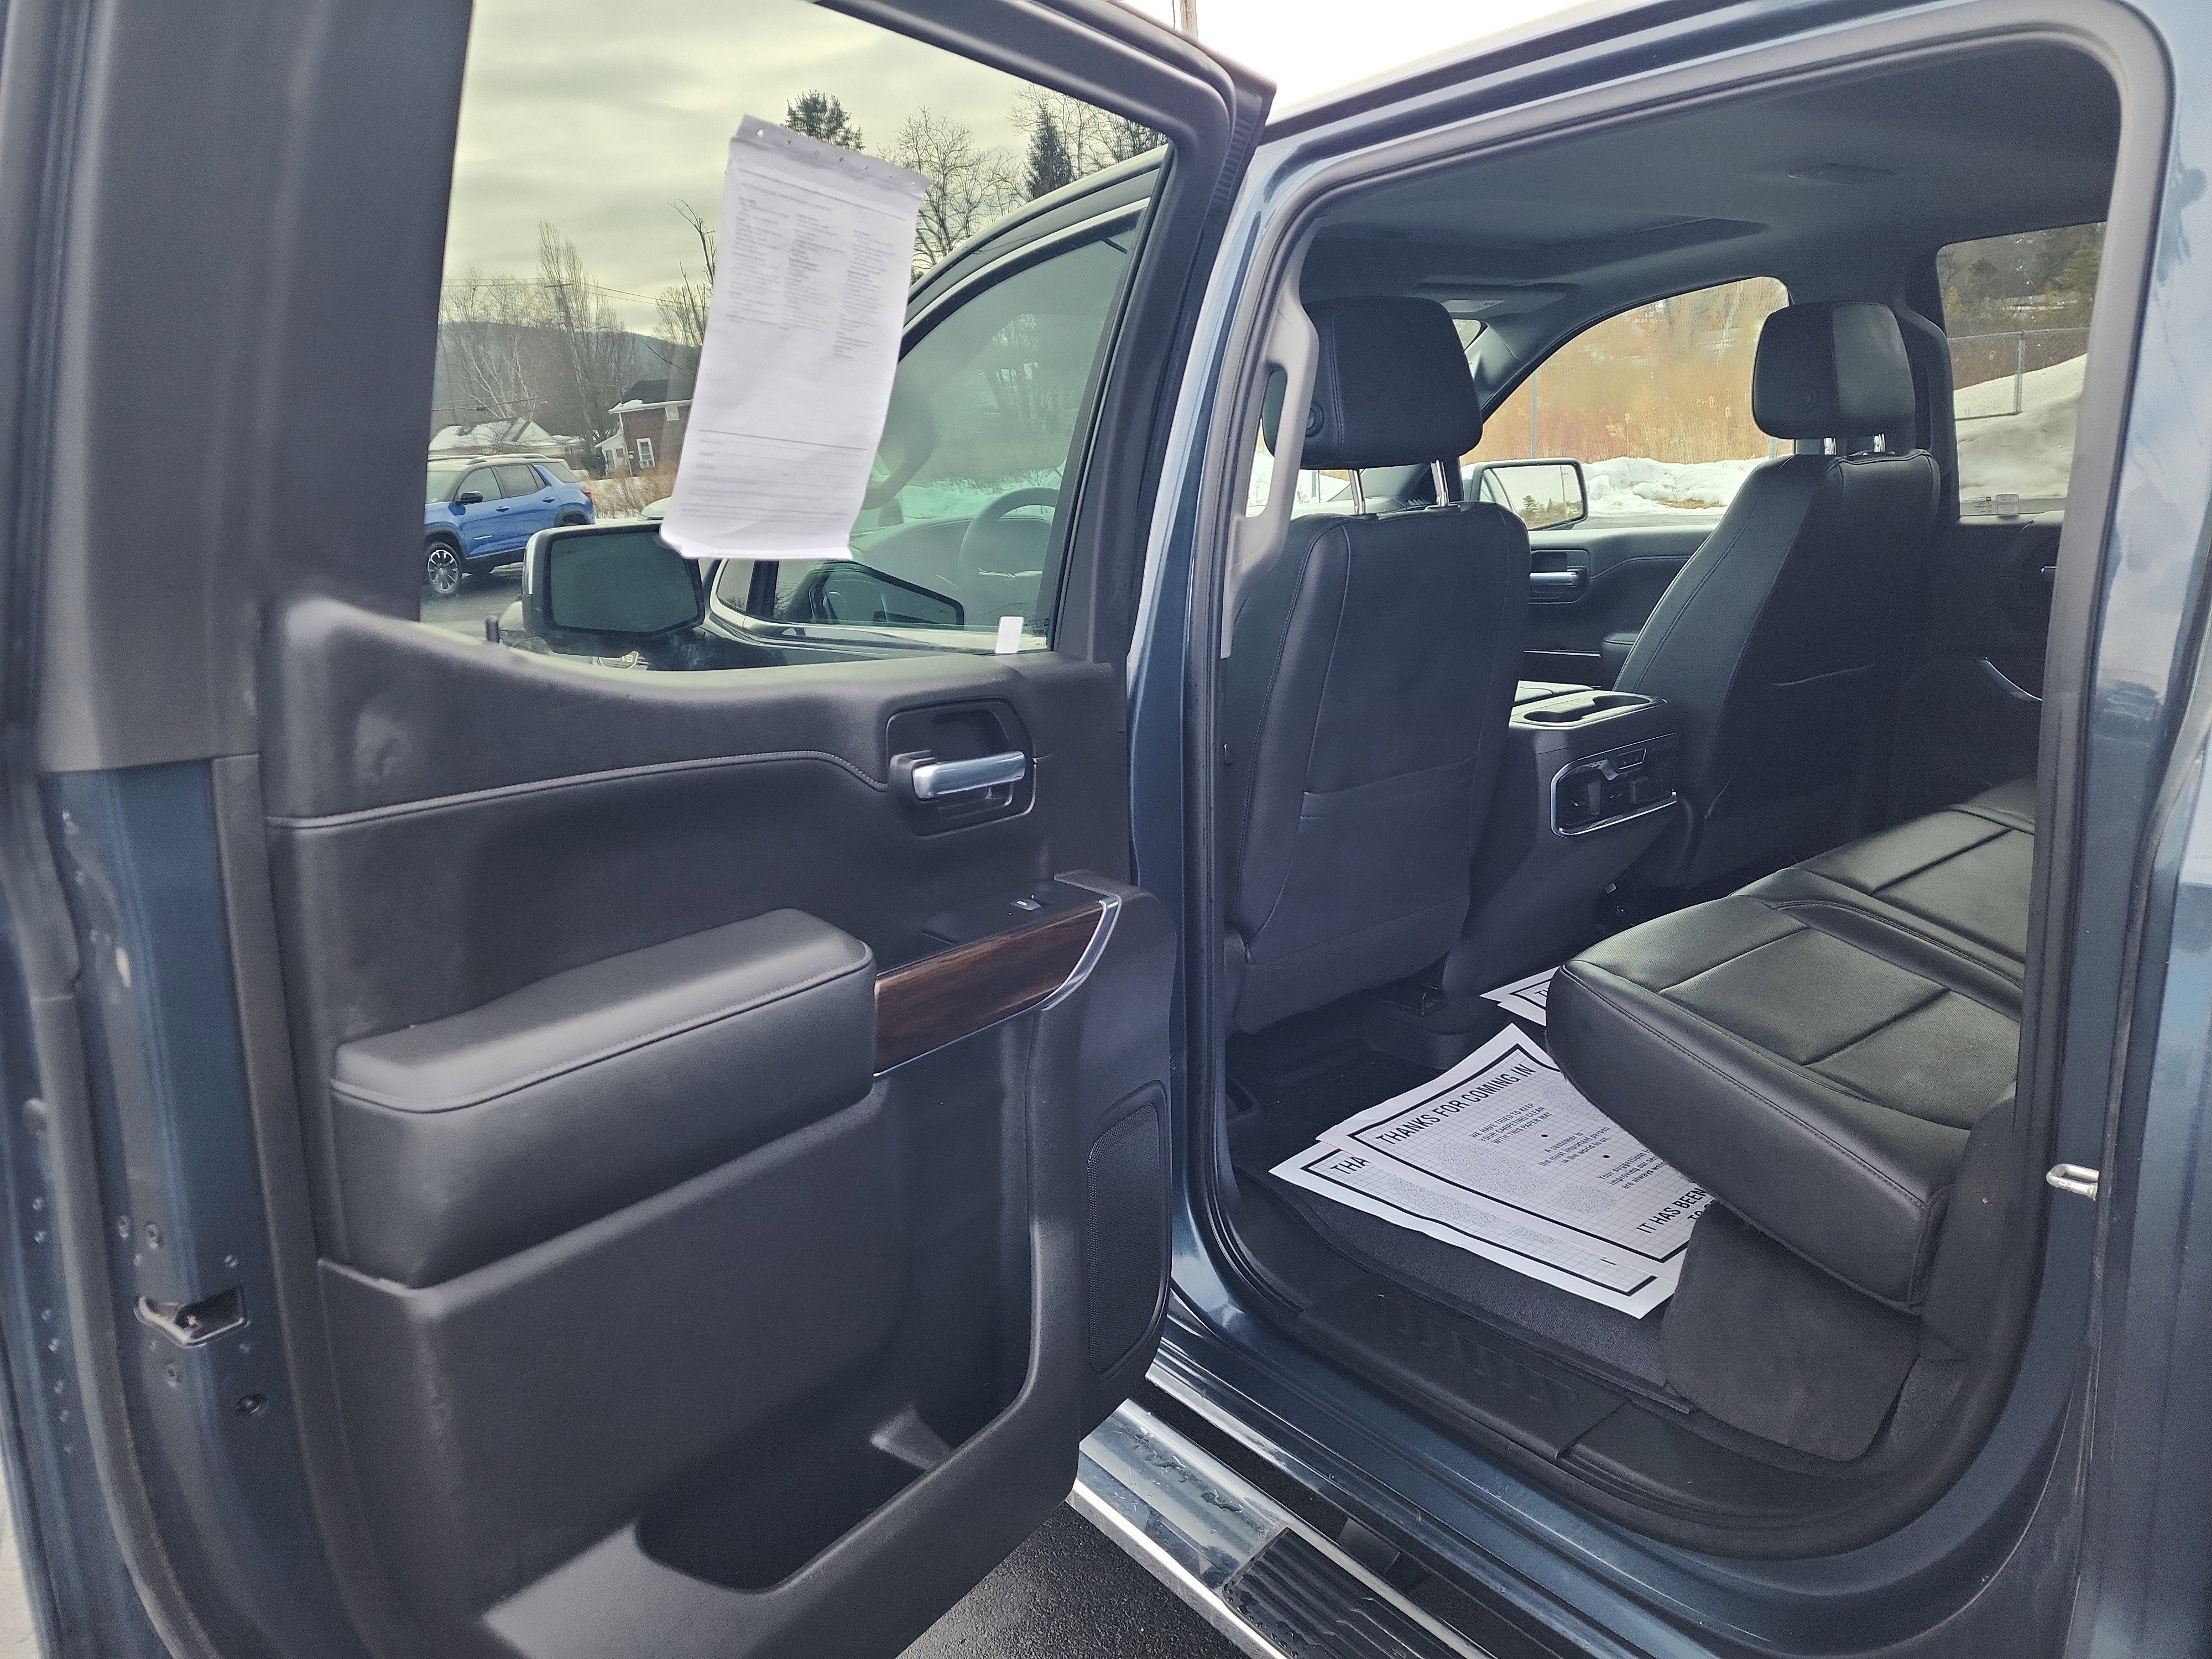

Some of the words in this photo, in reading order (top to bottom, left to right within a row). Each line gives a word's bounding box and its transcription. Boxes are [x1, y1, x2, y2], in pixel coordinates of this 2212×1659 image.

[1375, 1114, 1441, 1145] THANKS
[1432, 1100, 1471, 1118] FOR
[1461, 1073, 1521, 1103] COMING
[1510, 1063, 1537, 1077] IN
[1469, 1129, 1483, 1139] WE
[1479, 1123, 1498, 1133] HAVE
[1495, 1114, 1514, 1125] TRIED
[1520, 1103, 1534, 1113] KEEP
[1479, 1131, 1496, 1142] YOUR
[1495, 1116, 1528, 1134] CARPETING
[1526, 1107, 1546, 1118] CLEAN
[1492, 1134, 1510, 1144] WITH
[1507, 1127, 1524, 1136] THIS
[1521, 1118, 1541, 1130] PAPER
[1538, 1112, 1552, 1120] MAT
[1550, 1135, 1577, 1150] customer
[1550, 1151, 1566, 1161] most
[1562, 1136, 1593, 1153] important
[1590, 1127, 1610, 1139] person
[1577, 1144, 1595, 1154] world
[1597, 1171, 1614, 1180] Your
[1613, 1152, 1647, 1172] suggestions
[1607, 1167, 1641, 1185] improving
[1632, 1170, 1654, 1183] always
[1636, 1223, 1656, 1234] IT
[1648, 1207, 1681, 1225] HAS
[1672, 1187, 1707, 1209] BEEN
